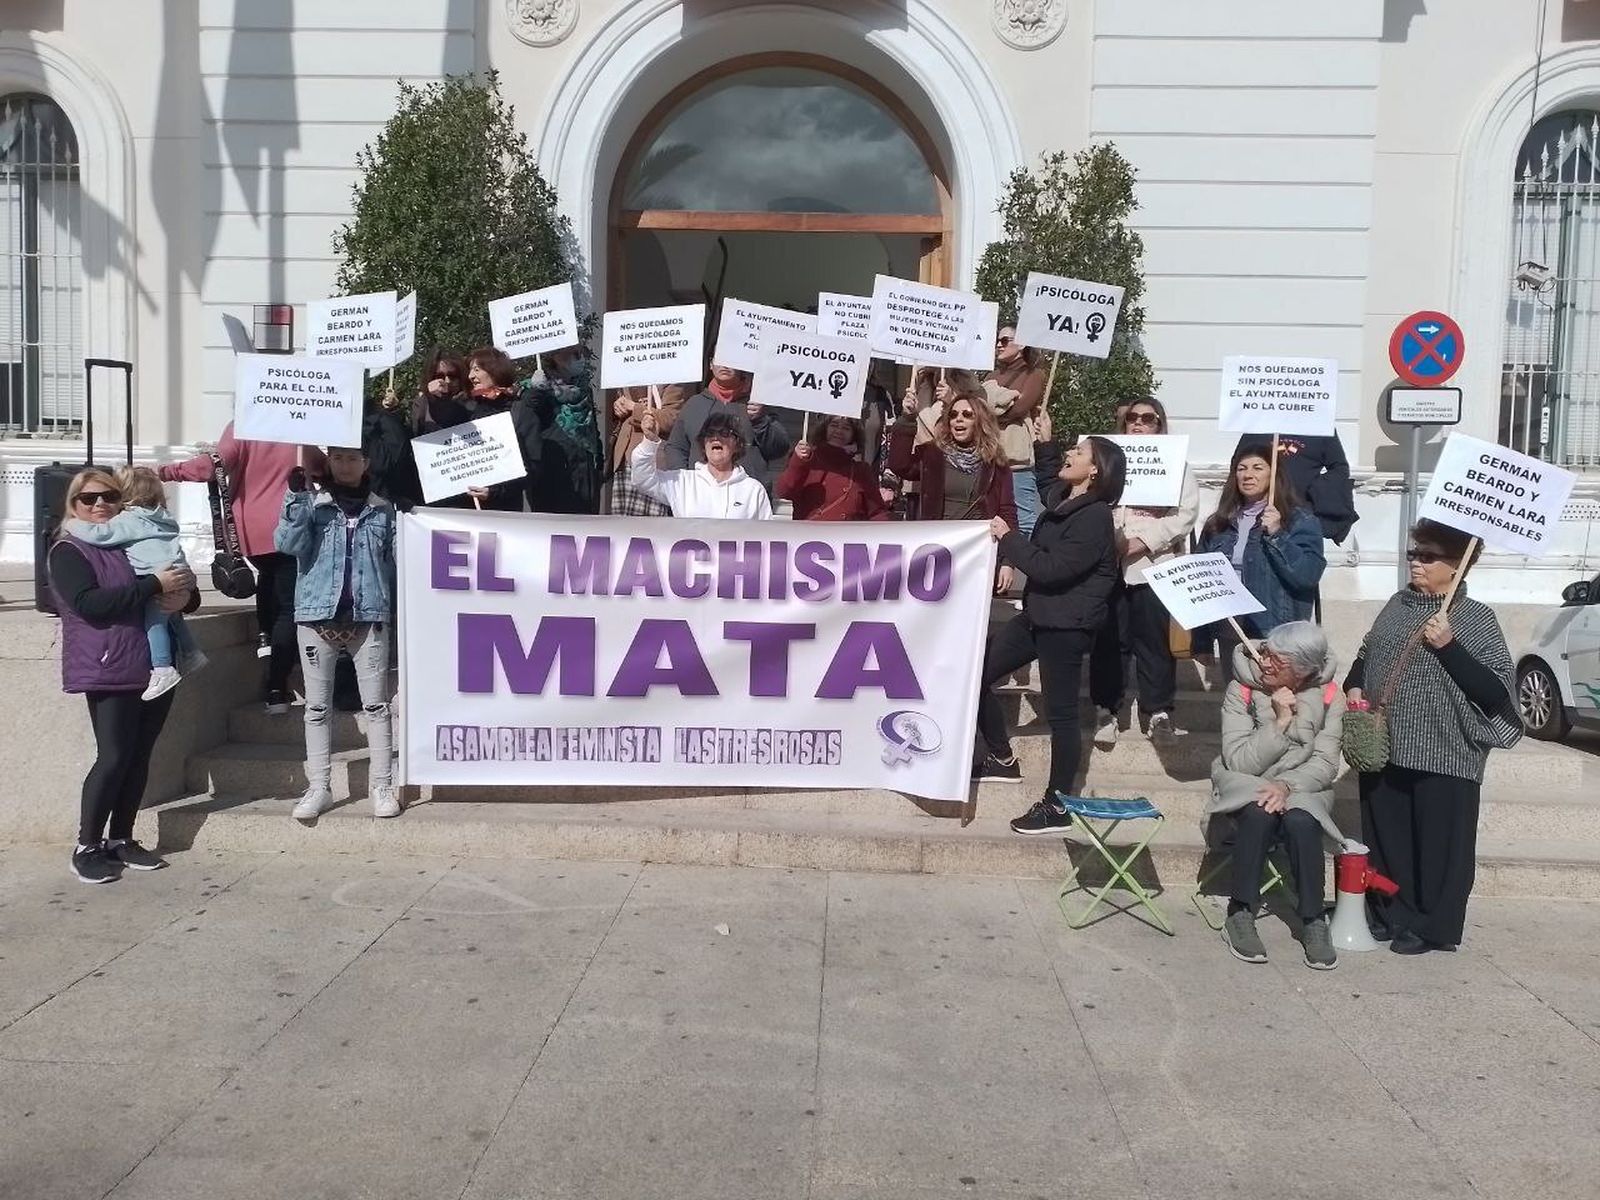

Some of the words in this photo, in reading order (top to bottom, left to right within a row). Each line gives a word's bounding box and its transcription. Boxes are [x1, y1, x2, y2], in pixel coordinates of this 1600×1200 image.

[1036, 286, 1115, 306] ¡PSICÓLOGA
[887, 302, 943, 320] DESPROTEGE
[954, 303, 966, 311] PP
[326, 320, 364, 331] BEARDO
[365, 319, 373, 327] Y
[512, 311, 545, 325] BEARDO
[620, 321, 636, 331] NOS
[638, 317, 684, 329] QUEDAMOS
[736, 309, 746, 317] EL
[747, 312, 806, 331] AYUNTAMIENTO
[840, 320, 865, 328] PLAZA
[889, 314, 923, 326] MUJERES
[1047, 313, 1079, 334] YA!
[505, 323, 540, 338] CARMEN
[541, 319, 564, 330] LARA
[743, 321, 755, 330] NO
[317, 334, 355, 344] CARMEN
[358, 332, 382, 341] LARA
[504, 329, 566, 347] IRRESPONSABLES
[619, 334, 633, 342] SIN
[901, 326, 956, 343] VIOLENCIAS
[316, 344, 383, 356] IRRESPONSABLES
[613, 345, 623, 353] EL
[625, 339, 689, 352] AYUNTAMIENTO
[894, 337, 947, 353] MACHISTAS
[623, 355, 636, 363] NO
[637, 354, 647, 362] LA
[649, 351, 677, 361] CUBRE
[776, 343, 856, 364] ¡PSICÓLOGA
[267, 367, 331, 380] PSICÓLOGA
[1238, 365, 1262, 374] NOS
[1264, 366, 1325, 375] QUEDAMOS
[789, 370, 823, 391] YA!
[1237, 378, 1256, 386] SIN
[1259, 377, 1321, 387] PSICÓLOGA
[259, 381, 288, 391] PARA
[291, 383, 305, 392] EL
[308, 384, 338, 395] C.I.M.
[1229, 389, 1243, 398] EL
[1245, 389, 1330, 400] AYUNTAMIENTO
[253, 395, 344, 409] ¡CONVOCATORIA
[1242, 402, 1259, 410] NO
[1261, 402, 1276, 411] LA
[1278, 403, 1316, 412] CUBRE
[289, 410, 307, 420] YA!
[430, 452, 467, 469] MUJERES
[440, 468, 451, 476] DE
[451, 453, 499, 472] VIOLENCIAS
[1136, 456, 1164, 465] C.I.M.
[449, 464, 495, 482] MACHISTAS
[1465, 469, 1526, 498] BEARDO
[1530, 491, 1540, 502] Y
[1443, 481, 1505, 511] CARMEN
[1508, 504, 1546, 526] LARA
[1434, 496, 1543, 542] IRRESPONSABLES
[431, 530, 514, 592] EL
[548, 534, 952, 602] MACHISMO
[1153, 571, 1167, 580] EL
[1167, 559, 1227, 576] AYUNTAMIENTO
[1171, 578, 1186, 587] NO
[1187, 569, 1212, 581] CUBRE
[1186, 580, 1215, 593] PLAZA
[457, 613, 925, 700] MATA
[436, 725, 552, 761] ASAMBLEA
[674, 726, 716, 764] LAS
[717, 727, 771, 765] TRES
[773, 729, 842, 765] ROSAS
